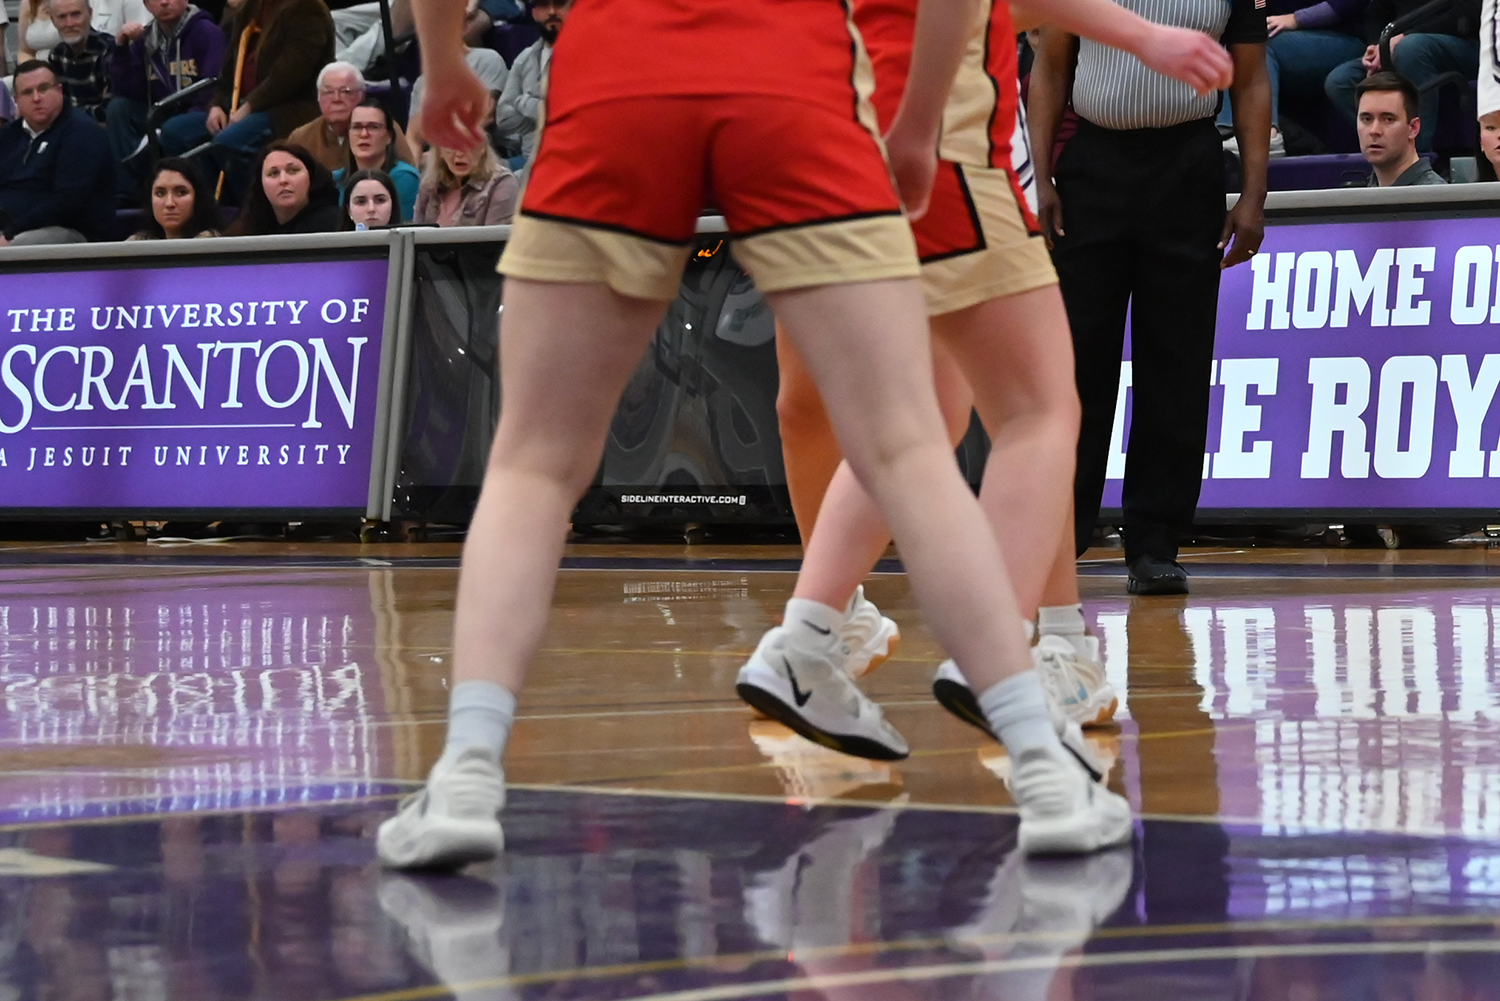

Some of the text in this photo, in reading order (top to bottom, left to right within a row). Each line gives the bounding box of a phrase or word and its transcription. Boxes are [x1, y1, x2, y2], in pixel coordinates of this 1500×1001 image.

[1246, 247, 1436, 331] HOME
[8, 298, 370, 333] THE UNIVERSITY OF
[0, 336, 369, 434] SCRANTON
[27, 445, 132, 472] JESUIT
[154, 444, 350, 467] UNIVERSITY
[621, 494, 738, 504] SIDELINEINTERACTIVE.COM
